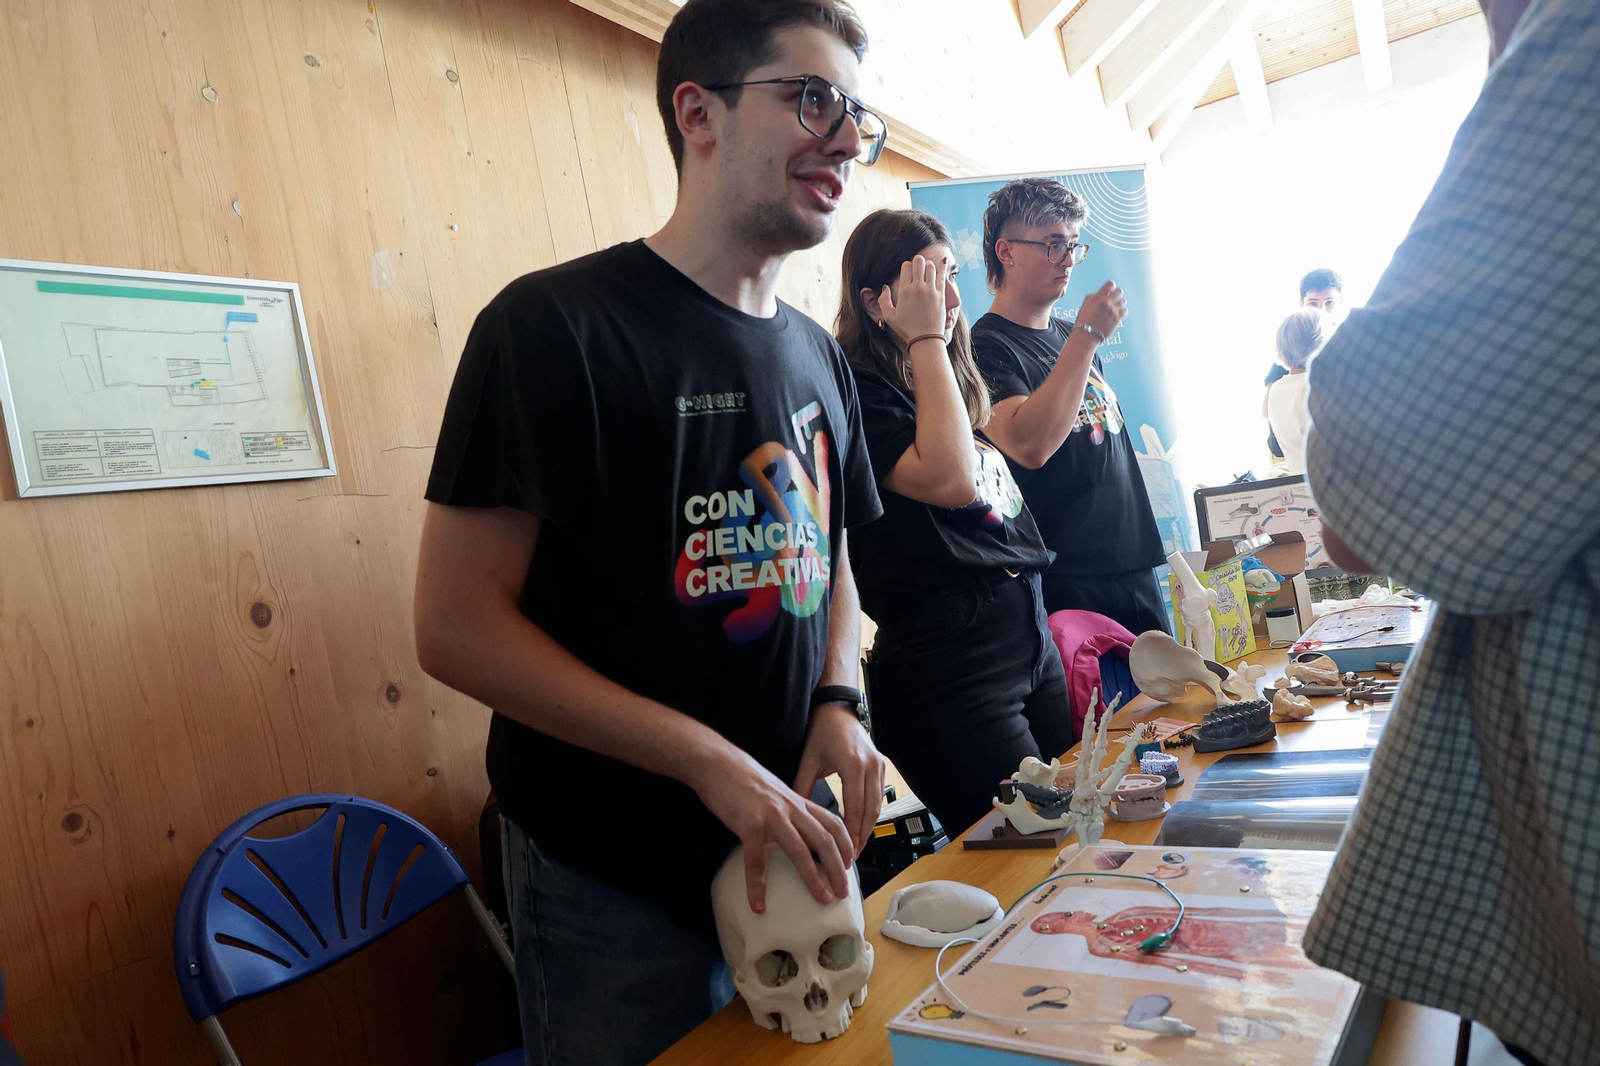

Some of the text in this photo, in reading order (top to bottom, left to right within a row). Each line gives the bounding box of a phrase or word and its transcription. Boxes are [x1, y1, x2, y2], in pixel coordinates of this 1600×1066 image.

[675, 392, 746, 412] G-NIGHT
[684, 489, 755, 525] CON
[685, 522, 818, 561] CIENCIAS
[685, 555, 830, 598] CREATIVAS
